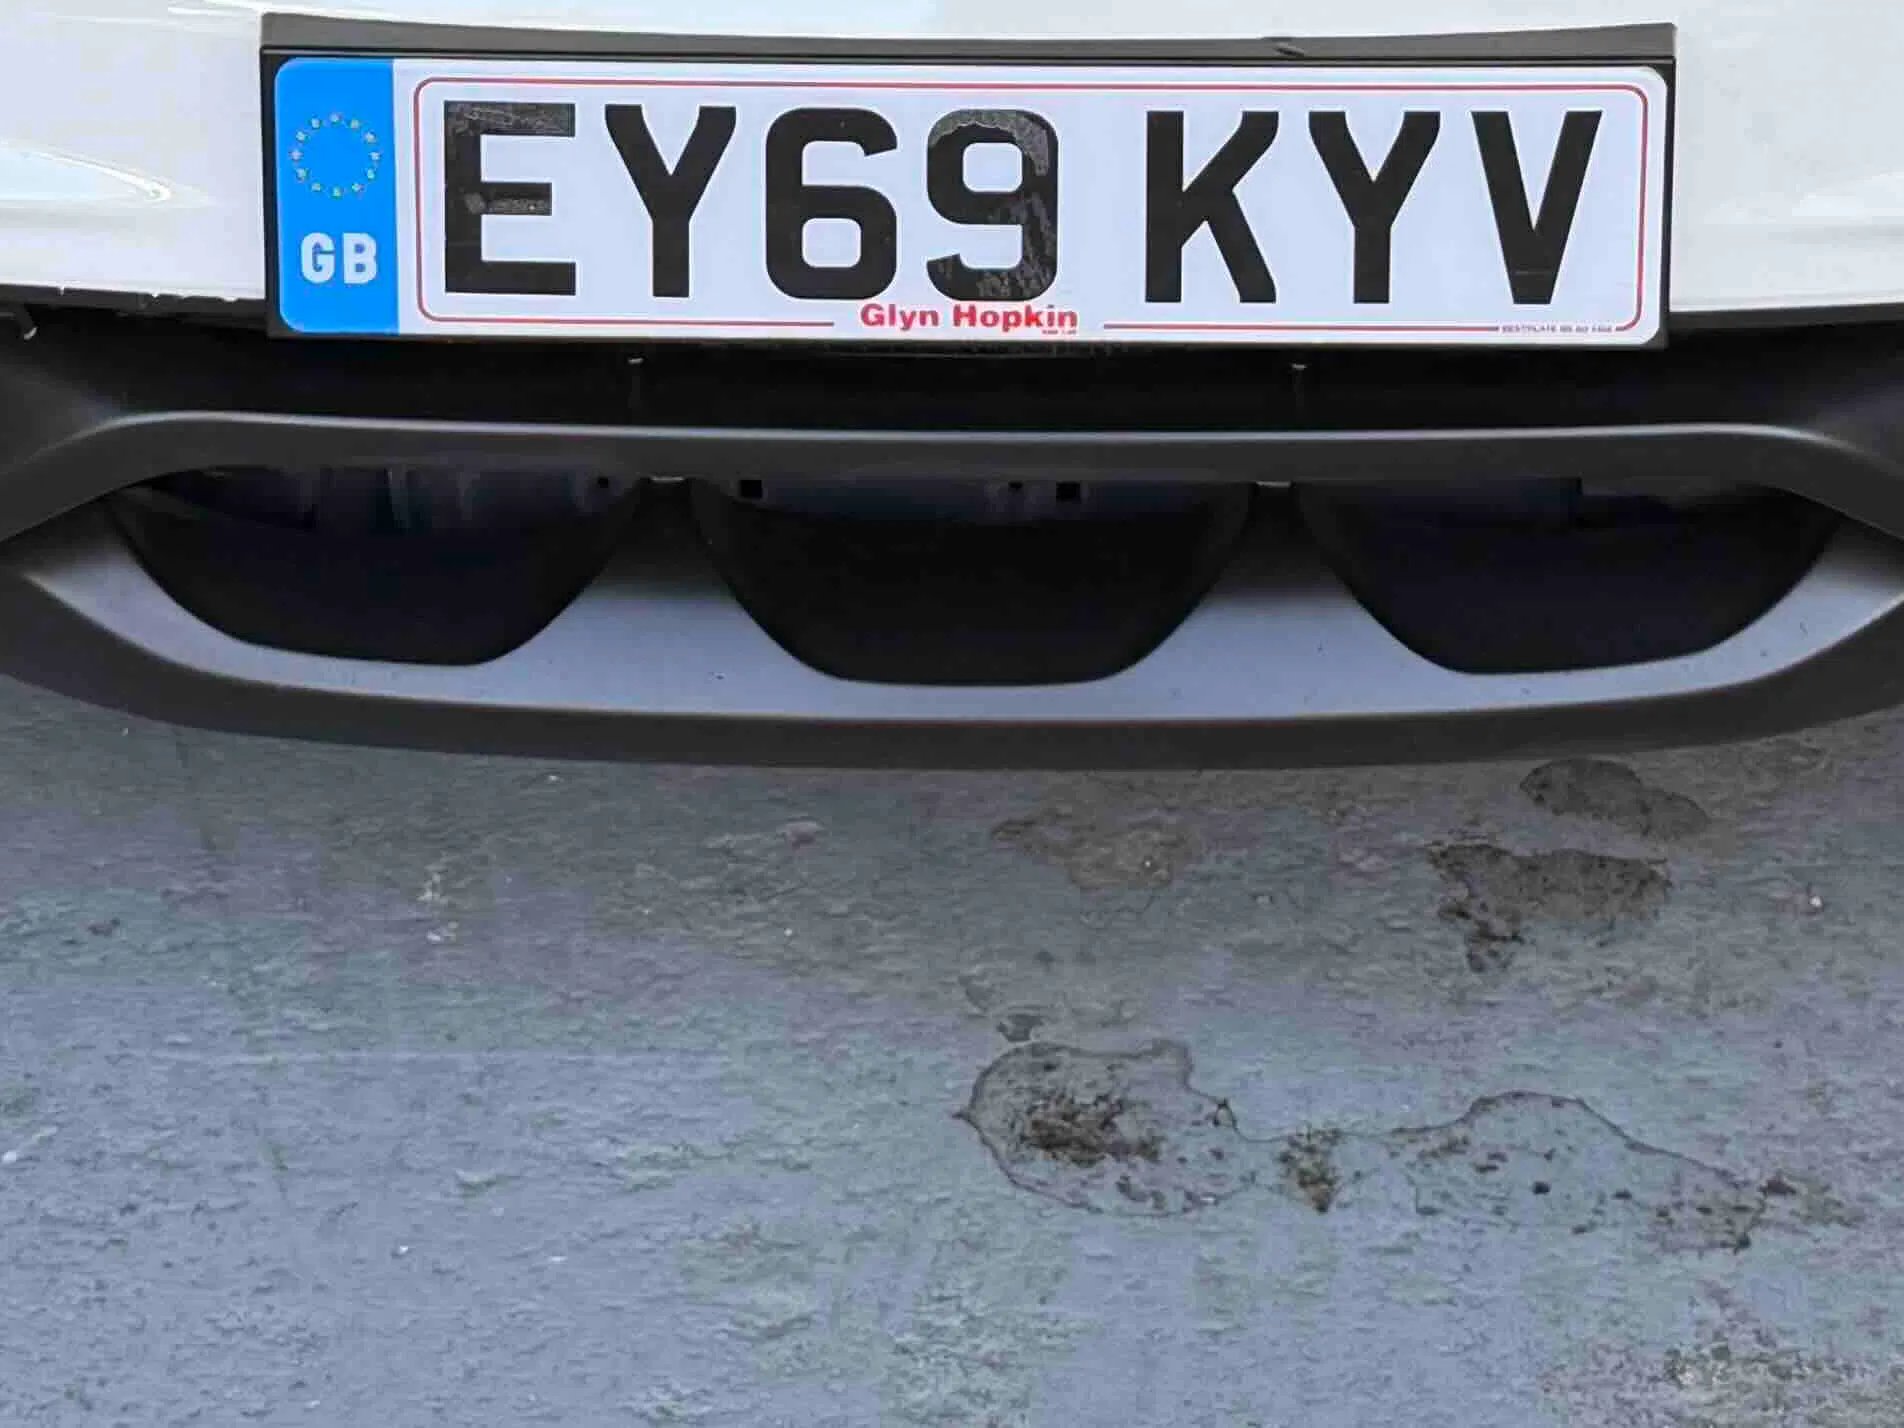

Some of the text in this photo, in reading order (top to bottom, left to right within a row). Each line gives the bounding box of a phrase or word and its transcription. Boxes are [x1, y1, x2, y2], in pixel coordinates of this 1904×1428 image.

[442, 100, 1602, 305] EY69 KYV
[300, 232, 378, 285] GB
[860, 302, 1079, 332] Glyn Hopkin
